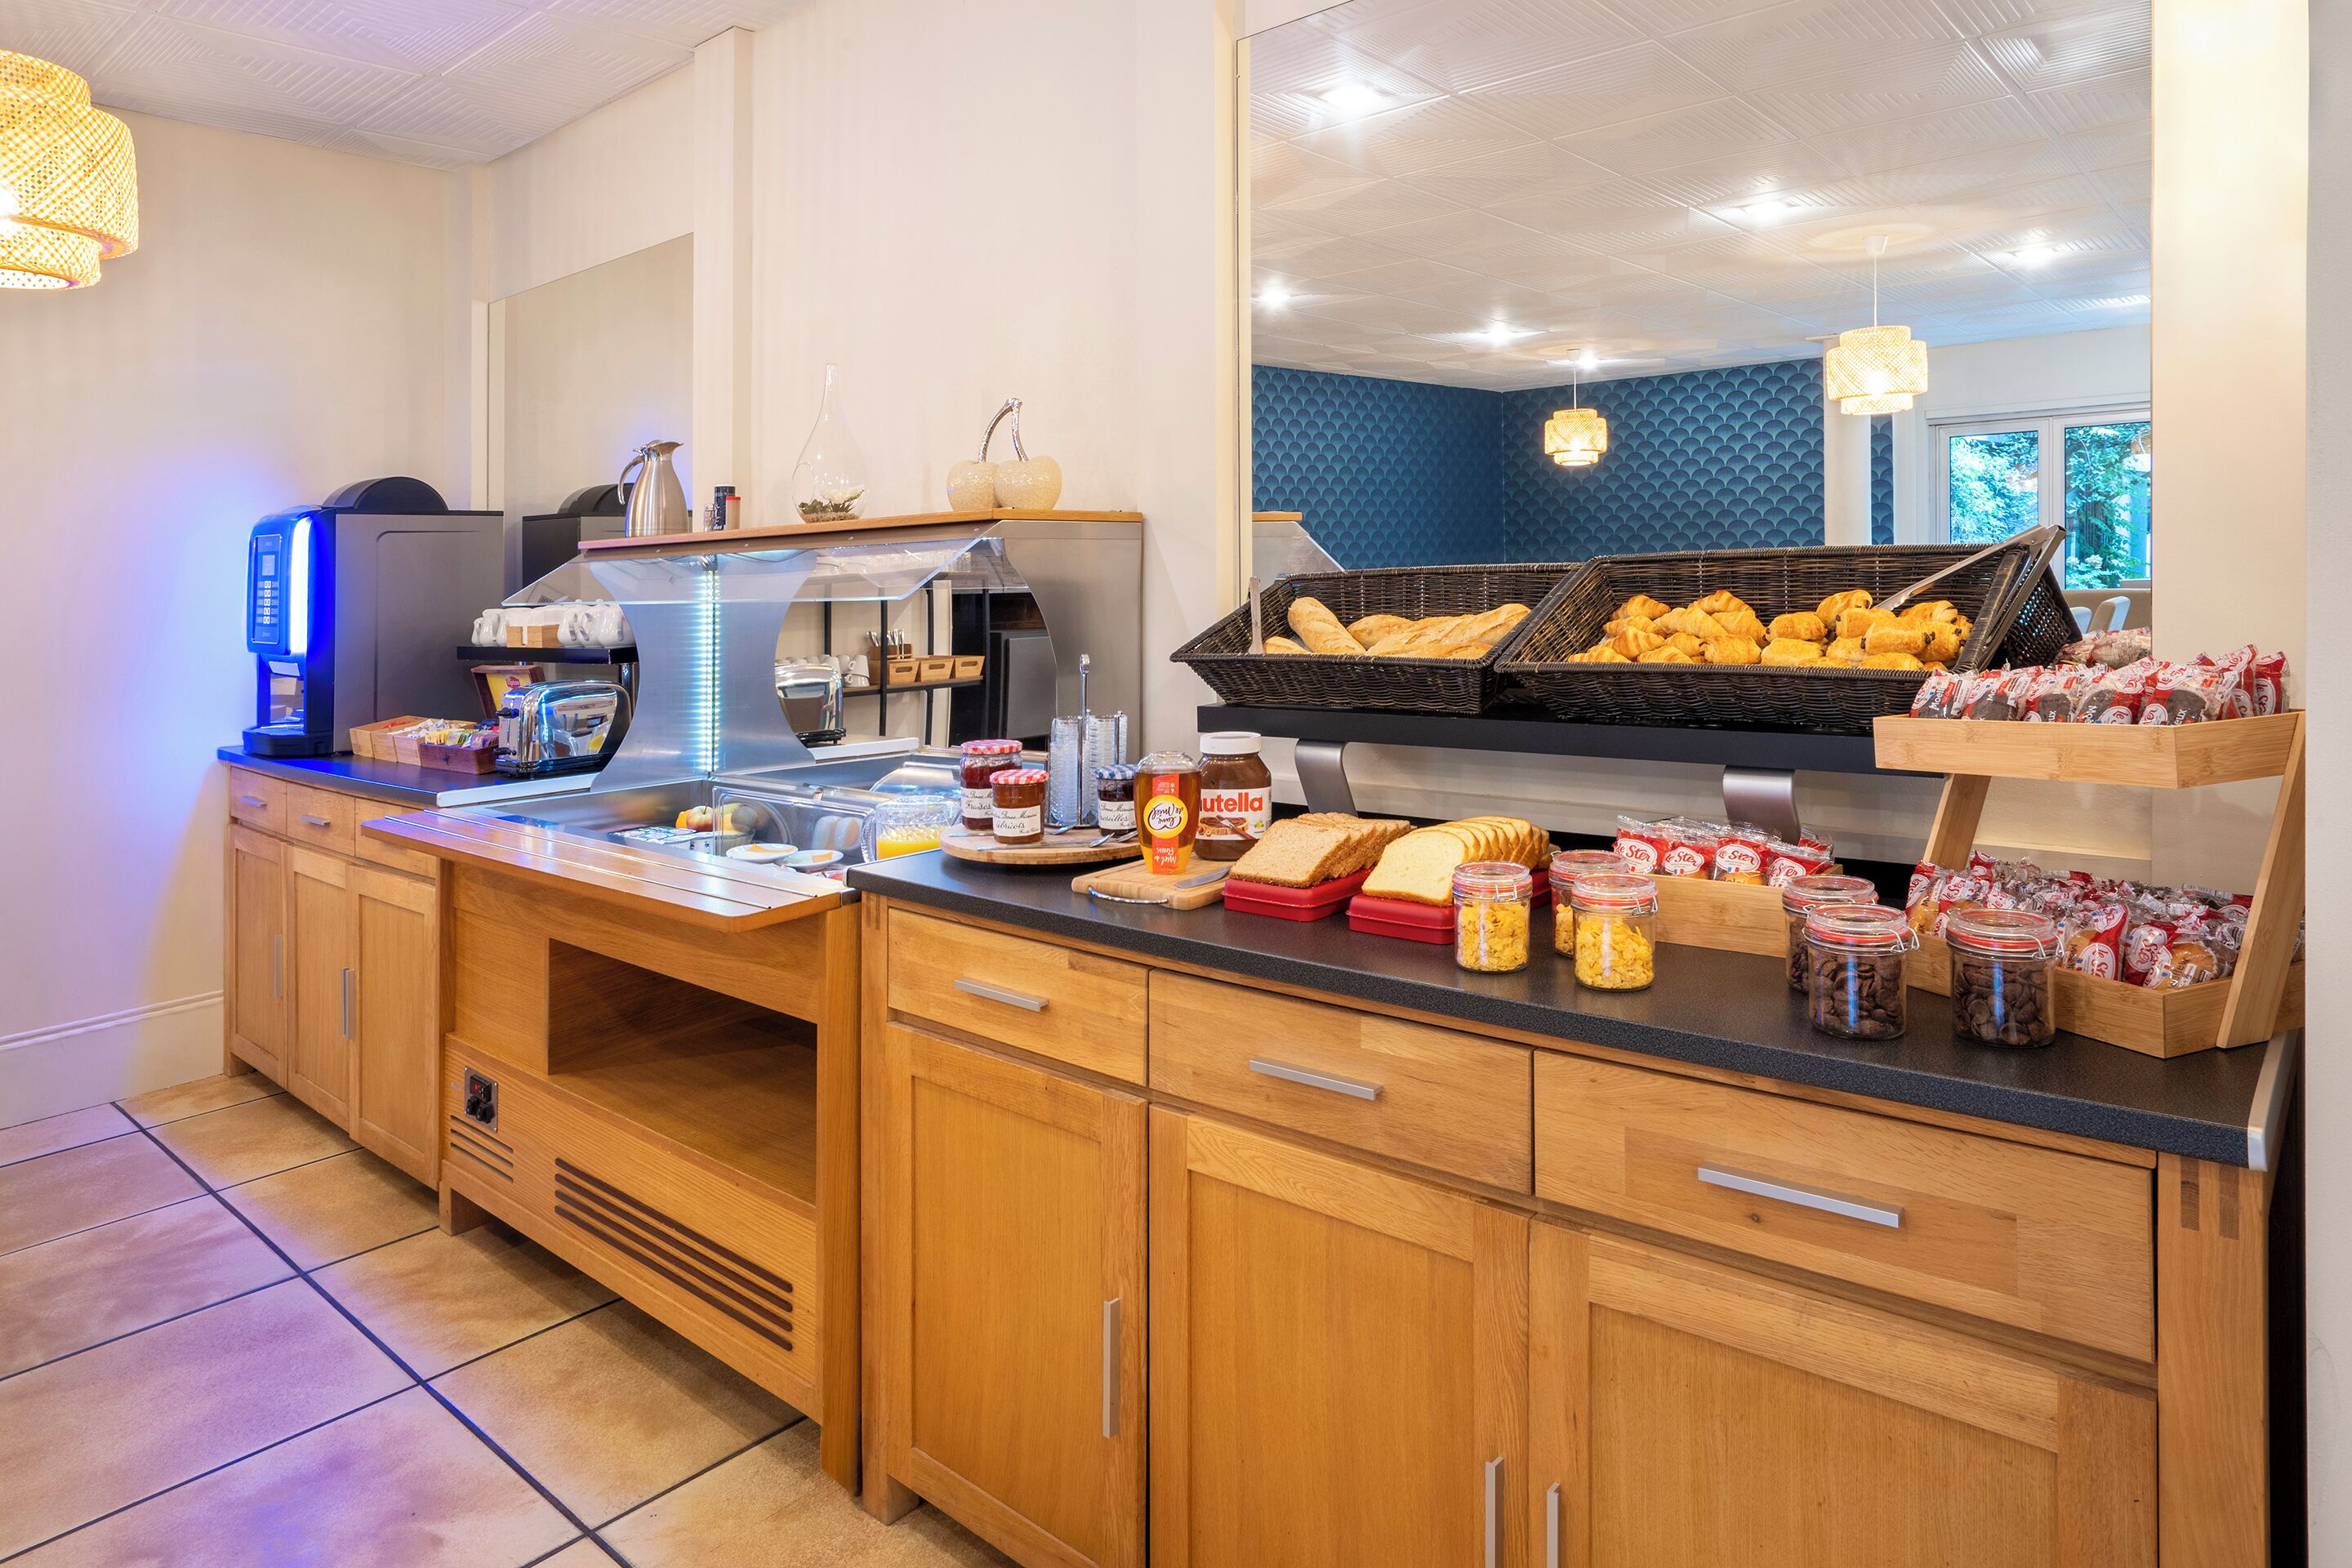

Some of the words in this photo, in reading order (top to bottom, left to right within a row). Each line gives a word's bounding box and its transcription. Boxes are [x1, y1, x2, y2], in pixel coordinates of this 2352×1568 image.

[1200, 792, 1263, 813] utella
[1626, 844, 1650, 862] Ster
[1674, 851, 1697, 866] Ster
